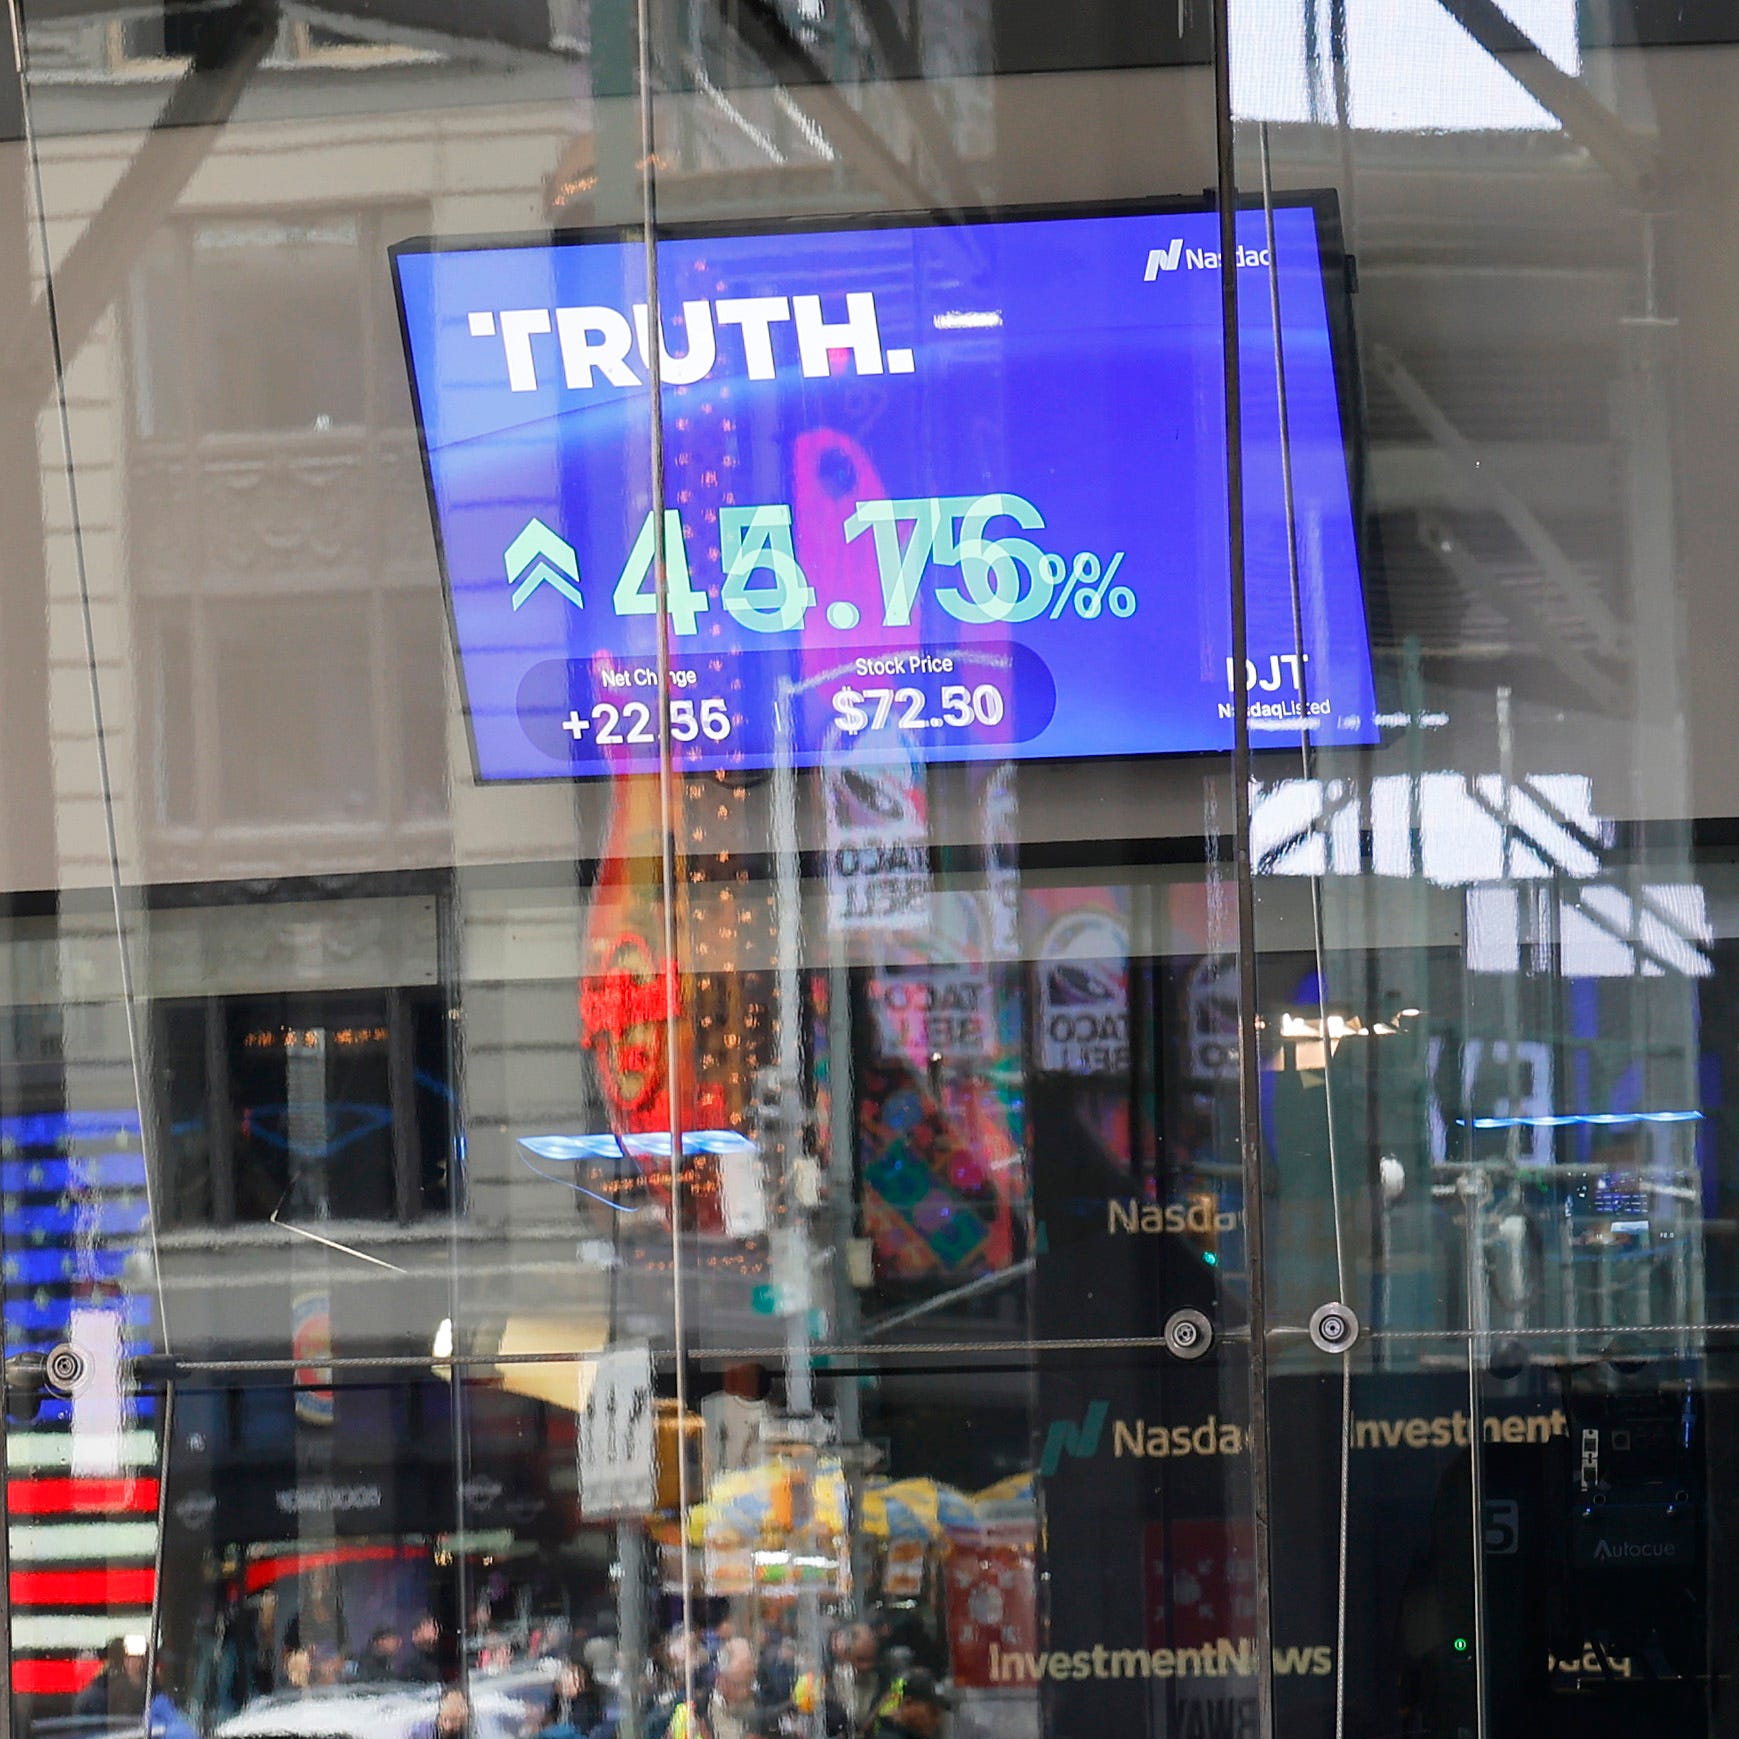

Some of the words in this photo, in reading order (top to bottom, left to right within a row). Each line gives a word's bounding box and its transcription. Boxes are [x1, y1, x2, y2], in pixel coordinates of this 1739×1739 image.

[469, 292, 914, 392] TRUTH.
[602, 669, 632, 687] Net
[634, 668, 697, 688] Chnge
[855, 656, 905, 676] Stock
[908, 655, 953, 675] Price
[1225, 654, 1308, 692] DJT
[1218, 699, 1331, 719] NdaqLised
[1108, 1197, 1240, 1235] Nasda
[1112, 1416, 1246, 1459] Nasda
[1346, 1410, 1568, 1451] Investment
[1593, 1538, 1677, 1563] Autocue
[989, 1637, 1333, 1682] InvestmentNws
